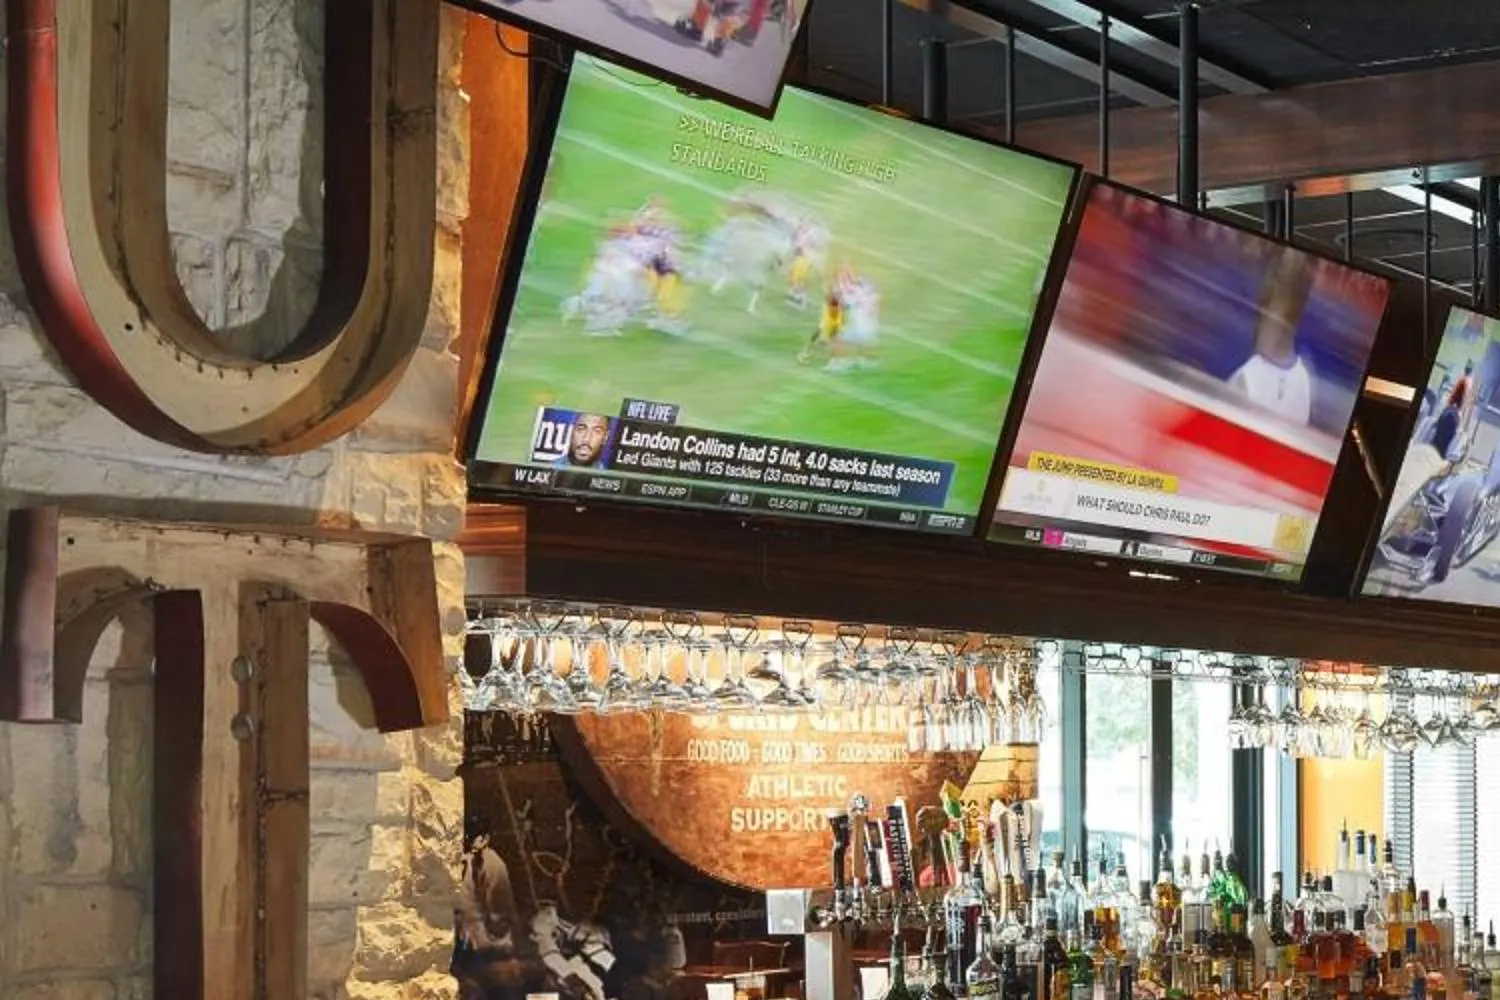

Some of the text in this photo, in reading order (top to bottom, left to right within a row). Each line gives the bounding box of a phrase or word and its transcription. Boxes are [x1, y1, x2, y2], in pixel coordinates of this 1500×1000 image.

[627, 402, 674, 421] NFL LIVE
[620, 426, 941, 485] Landon Collins had 5 Int, 4.0 sacks last season
[1037, 457, 1052, 470] THE
[514, 468, 551, 485] W LAX
[590, 477, 621, 491] NEWS
[616, 451, 639, 465] Led
[641, 453, 677, 469] Giants
[679, 458, 701, 473] with
[704, 460, 725, 475] 125
[725, 463, 762, 479] tackles
[763, 466, 781, 485] (33
[781, 471, 808, 486] more
[809, 474, 832, 489] than
[832, 477, 851, 493] any
[1077, 495, 1105, 511] WHAT
[1106, 498, 1142, 515] SHOULD
[1143, 505, 1169, 520] CHRIS
[1169, 510, 1191, 524] PAUL
[719, 740, 750, 764] FOOD
[747, 773, 848, 799] ATHLETIC
